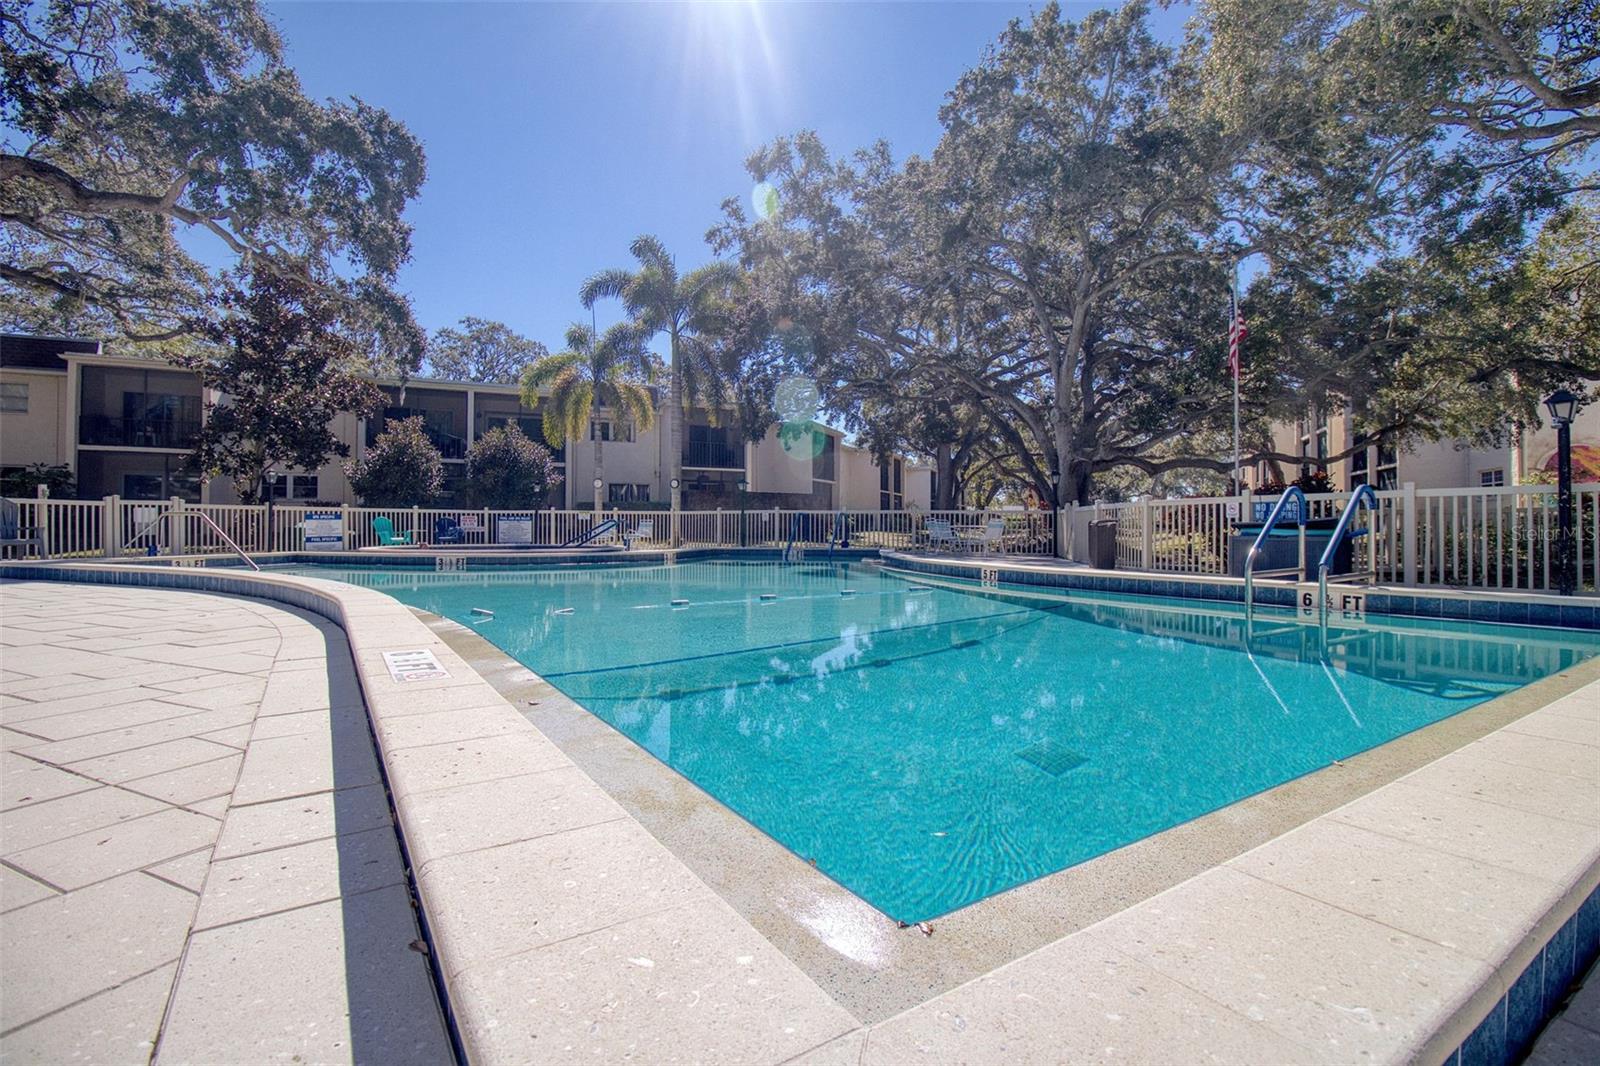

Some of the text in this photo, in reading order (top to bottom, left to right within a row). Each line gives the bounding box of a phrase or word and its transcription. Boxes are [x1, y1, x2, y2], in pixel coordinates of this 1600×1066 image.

[1255, 503, 1297, 511] NO DNG
[983, 569, 997, 580] 5 FT
[1303, 592, 1313, 607] 6
[1342, 595, 1362, 611] FT
